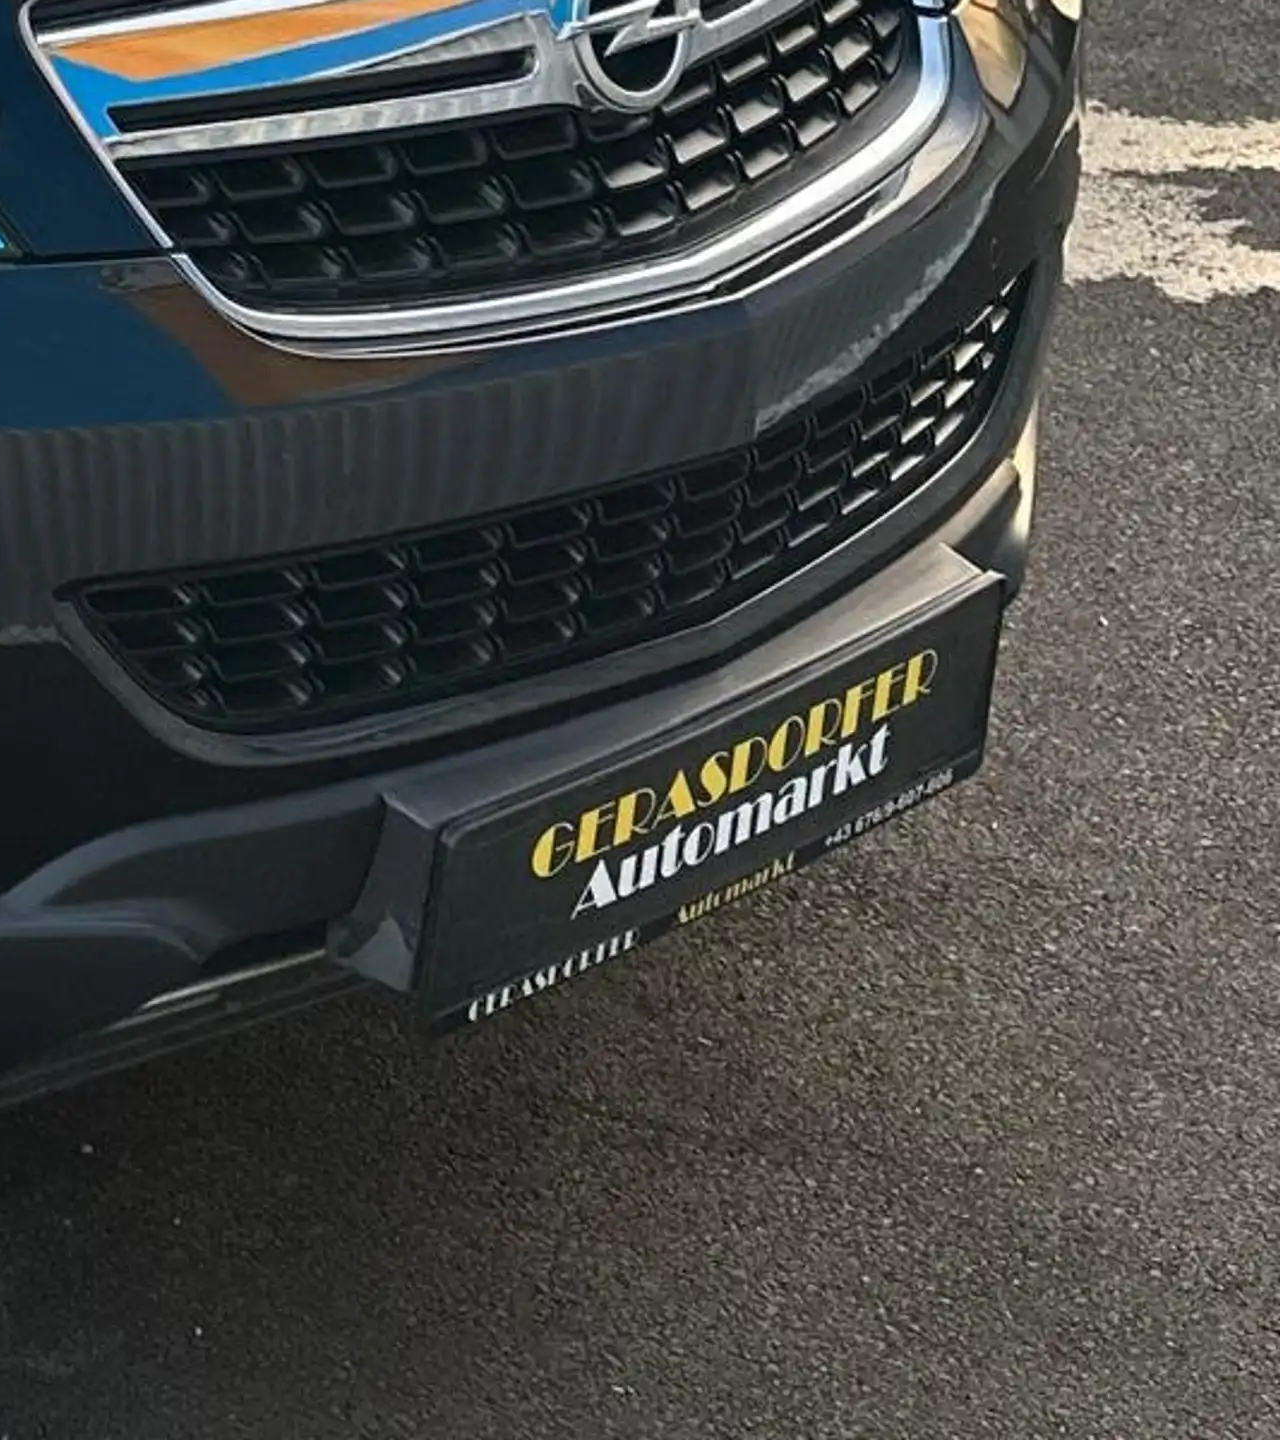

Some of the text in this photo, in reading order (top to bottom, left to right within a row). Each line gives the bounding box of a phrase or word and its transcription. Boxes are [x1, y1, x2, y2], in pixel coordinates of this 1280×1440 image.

[530, 648, 939, 878] GERASDORFER
[570, 723, 891, 921] Automarkt
[677, 849, 795, 924] Automarkt
